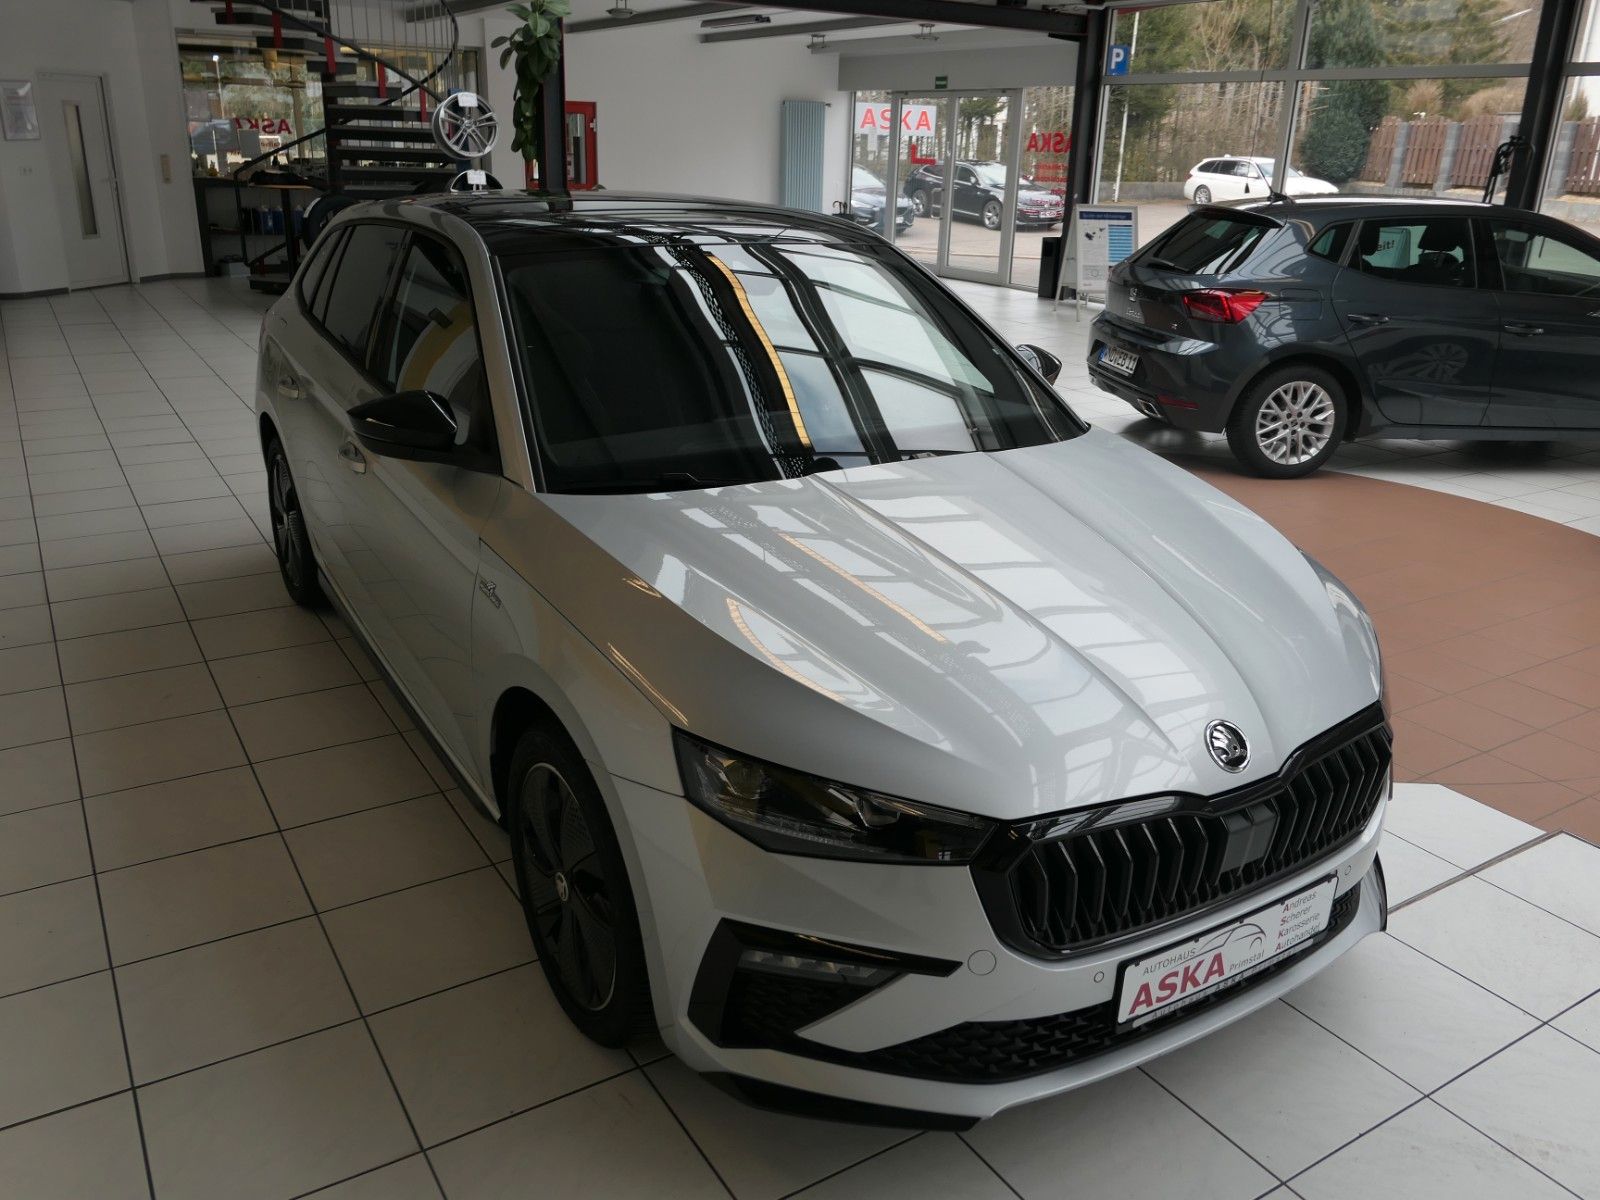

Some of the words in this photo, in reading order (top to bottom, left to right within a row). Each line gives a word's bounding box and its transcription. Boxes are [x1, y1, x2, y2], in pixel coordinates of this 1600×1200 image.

[1111, 48, 1124, 69] P
[860, 108, 931, 131] ASKA
[1282, 891, 1317, 913] Andreas
[1277, 913, 1320, 939] Karosserie
[1280, 906, 1312, 926] Scherer
[1143, 948, 1197, 976] AUTOHAUS
[1229, 950, 1265, 971] Primstal
[1128, 952, 1225, 1015] ASKA
